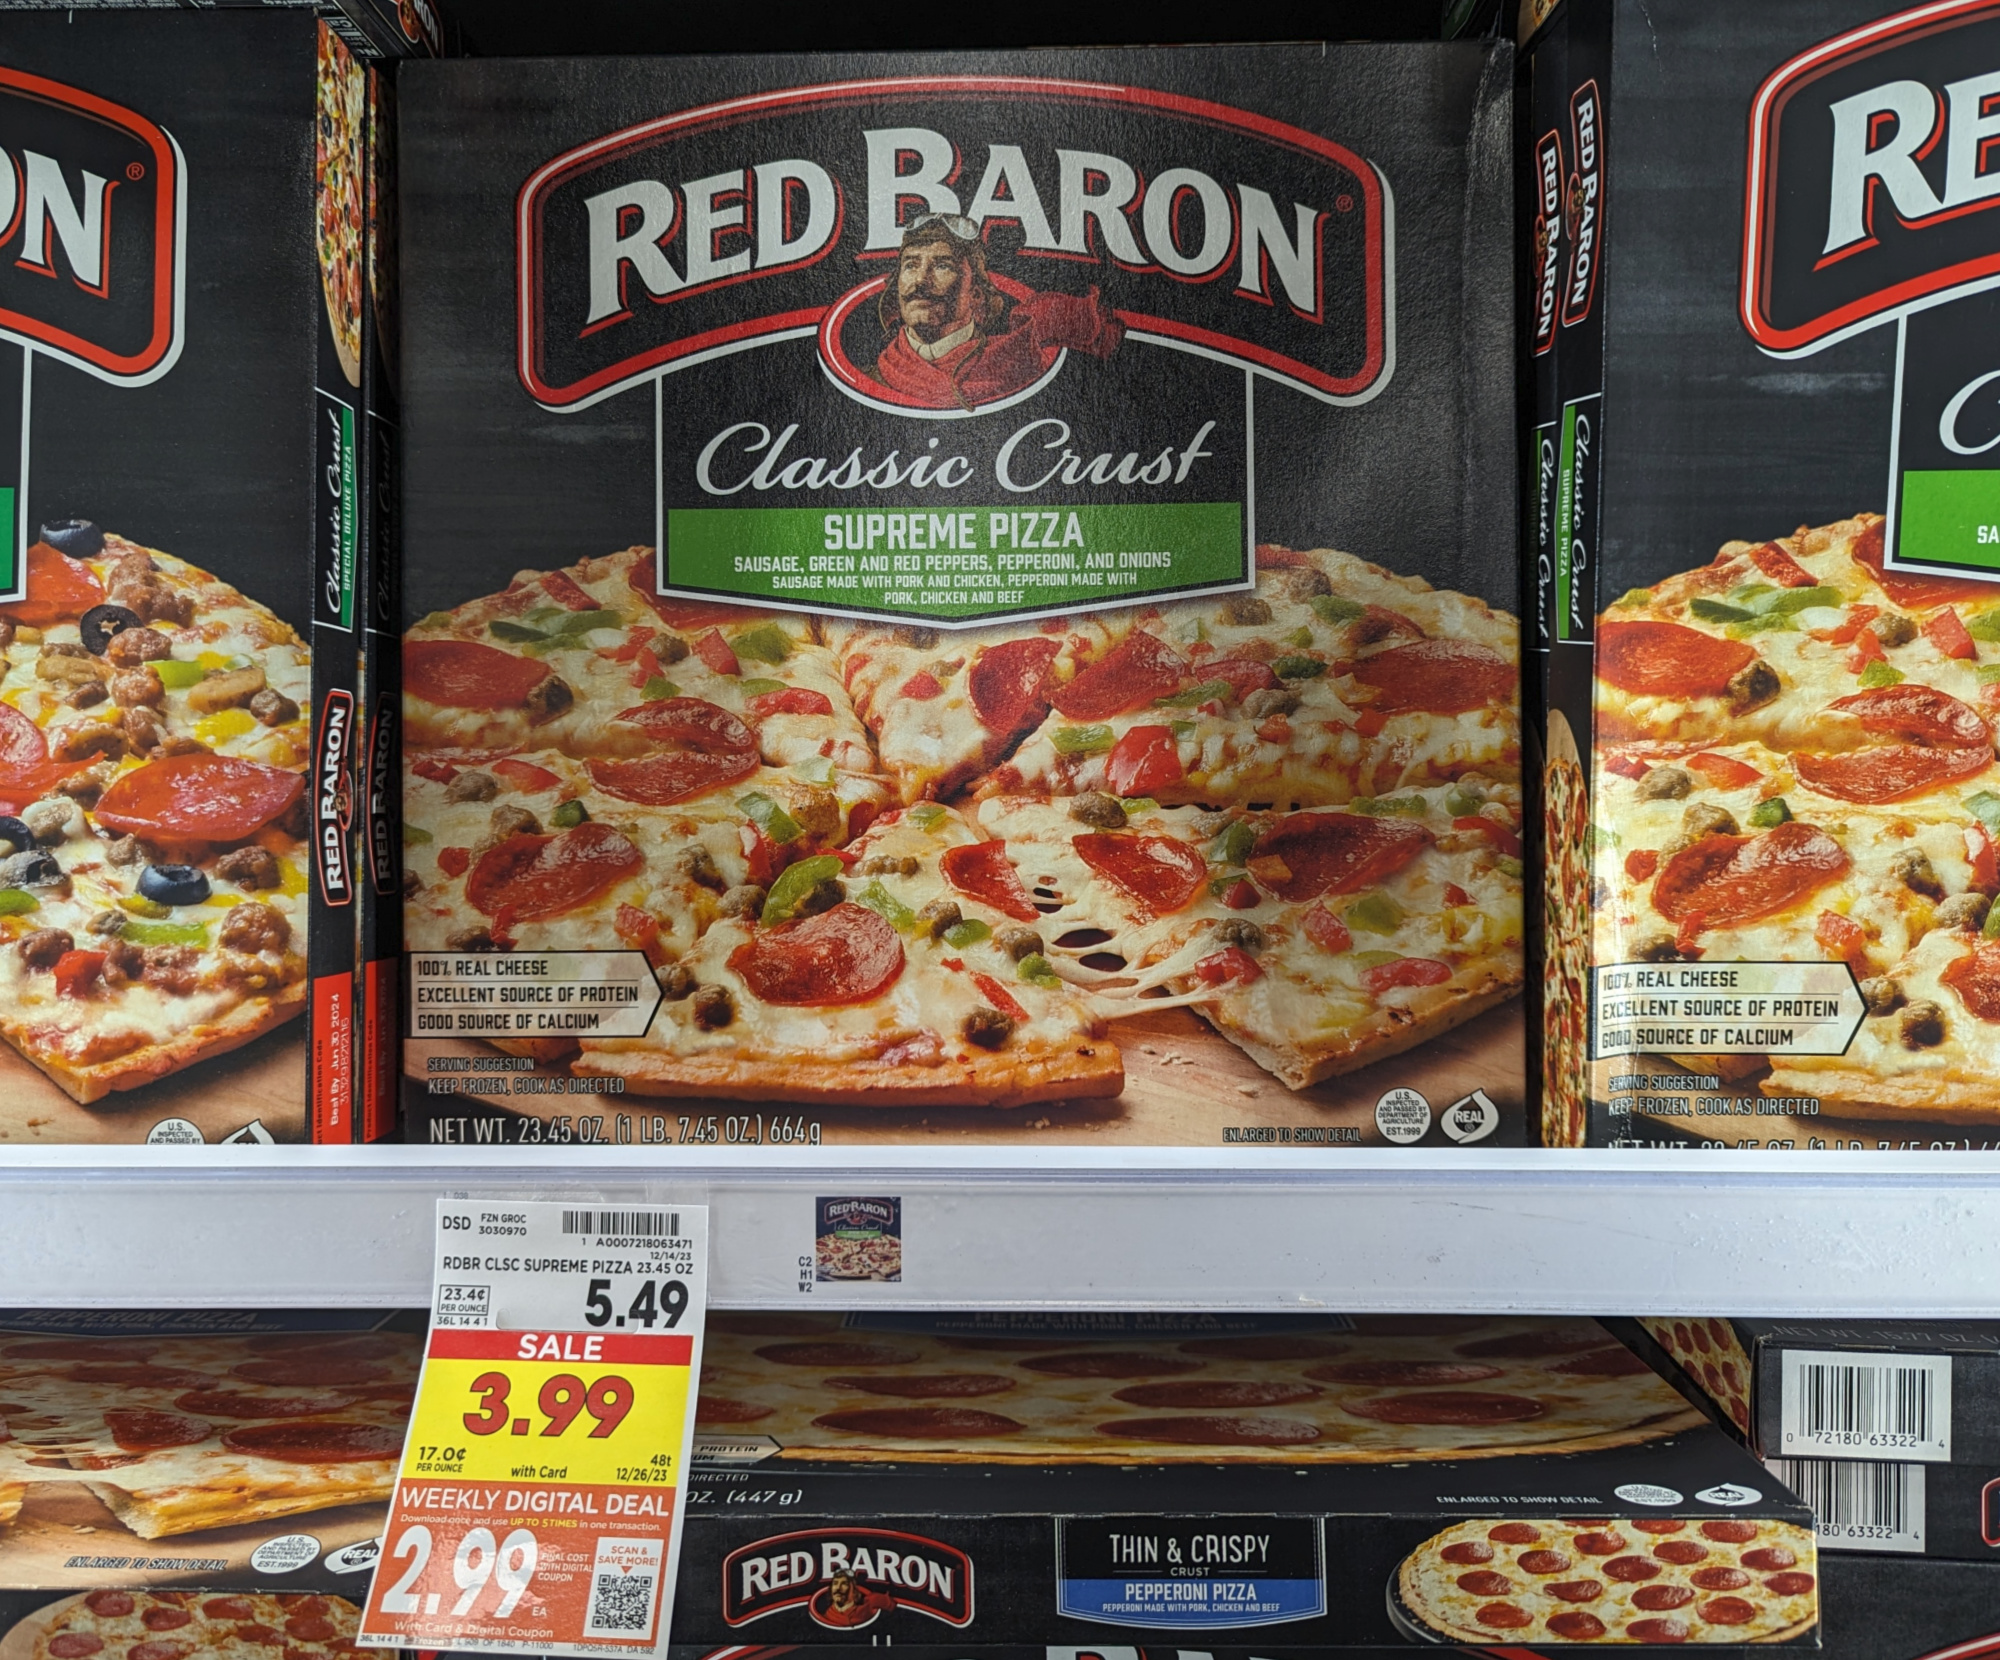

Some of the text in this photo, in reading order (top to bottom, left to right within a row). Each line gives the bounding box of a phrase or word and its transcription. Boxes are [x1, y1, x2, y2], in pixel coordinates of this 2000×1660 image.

[1571, 97, 1598, 306] RED BARON
[584, 127, 1320, 325] RED BARON
[697, 417, 1217, 496] Classic Crust
[326, 407, 342, 614] Classic Crust
[342, 446, 352, 592] SPECIAL DELUXE PIZZA
[1559, 468, 1570, 577] SUPREME PIZZA
[1570, 413, 1591, 631] Classic Crust
[824, 511, 1085, 551] SUPREME PIZZA
[734, 551, 1172, 575] SAUSAGE, GREEN AND RED PEPPERS, PEPPERONI, AND ONIONS
[772, 573, 1138, 589] SAUSAGE MADE WITH PORK AND CHICKEN, PEPPERONI MADE WITH
[884, 591, 1025, 606] PORK, CHICKEN AND BEEF
[321, 707, 346, 890] RED BARON
[417, 960, 549, 977] 100% REAL CHEESE
[417, 987, 639, 1003] EXCELLENT SOURCE OF PROTEIN
[1602, 1000, 1839, 1020] EXCELLENT SOURCE OF PROTEIN
[417, 1014, 600, 1030] GOOD SOURCE OF CALCIUM
[427, 1057, 535, 1073] SERVING SUGGESTION
[427, 1078, 625, 1095] KEEP FROZEN, COOK AS DIRECTED
[1395, 1091, 1412, 1100] U.S.
[1455, 1110, 1485, 1123] REAL
[429, 1117, 822, 1144] NET WT. 23.45 OZ. (1 LB. 7.45 OZ.) 664g
[1222, 1127, 1362, 1142] ENLARGED TO SHOW DETAIL
[1386, 1126, 1421, 1136] EST.1999
[442, 1216, 471, 1230] DSD
[481, 1213, 527, 1224] FZN GROC
[478, 1226, 527, 1236] 3030970
[596, 1238, 693, 1249] A0007218063471
[650, 1250, 692, 1262] 12/14/23
[798, 1256, 812, 1267] C2
[443, 1257, 694, 1275] RDBR CLSC SUPREME PIZZA 23.45 OZ
[800, 1269, 812, 1280] H1
[444, 1287, 486, 1302] 23.4¢
[798, 1282, 812, 1293] W2
[440, 1303, 488, 1314] PER OUNCE
[584, 1278, 689, 1329] 5.49
[517, 1333, 605, 1361] SALE
[463, 1371, 635, 1439] 3.99
[1786, 1432, 1945, 1449] 0 72180 63322 4
[418, 1446, 467, 1462] 17.0¢
[650, 1454, 672, 1467] 48t
[416, 1462, 464, 1473] PER OUNCE
[511, 1465, 568, 1478] with Card
[616, 1467, 668, 1482] 12/26/23
[401, 1487, 670, 1517] WEEKLY DIGITAL DEAL
[400, 1514, 447, 1524] Download
[473, 1516, 490, 1525] and
[492, 1518, 508, 1526] use
[510, 1517, 524, 1526] UP
[525, 1518, 540, 1527] TO
[549, 1518, 578, 1528] TIMES
[579, 1519, 587, 1528] in
[589, 1521, 607, 1529] one
[609, 1521, 662, 1531] transaction.
[611, 1546, 648, 1555] SCAN &
[1109, 1534, 1270, 1564] THIN & CRISPY
[566, 1553, 590, 1562] COST
[598, 1555, 659, 1566] SAVE MORE!
[380, 1525, 539, 1618] 2.99
[561, 1562, 593, 1572] DIGITAL
[740, 1542, 953, 1601] RED BARON
[1170, 1567, 1210, 1577] CRUST
[538, 1572, 573, 1582] COUPON
[1125, 1583, 1257, 1601] PEPPERONI PIZZA
[531, 1606, 548, 1617] EA
[394, 1621, 554, 1640] With Card & Digital Coupon
